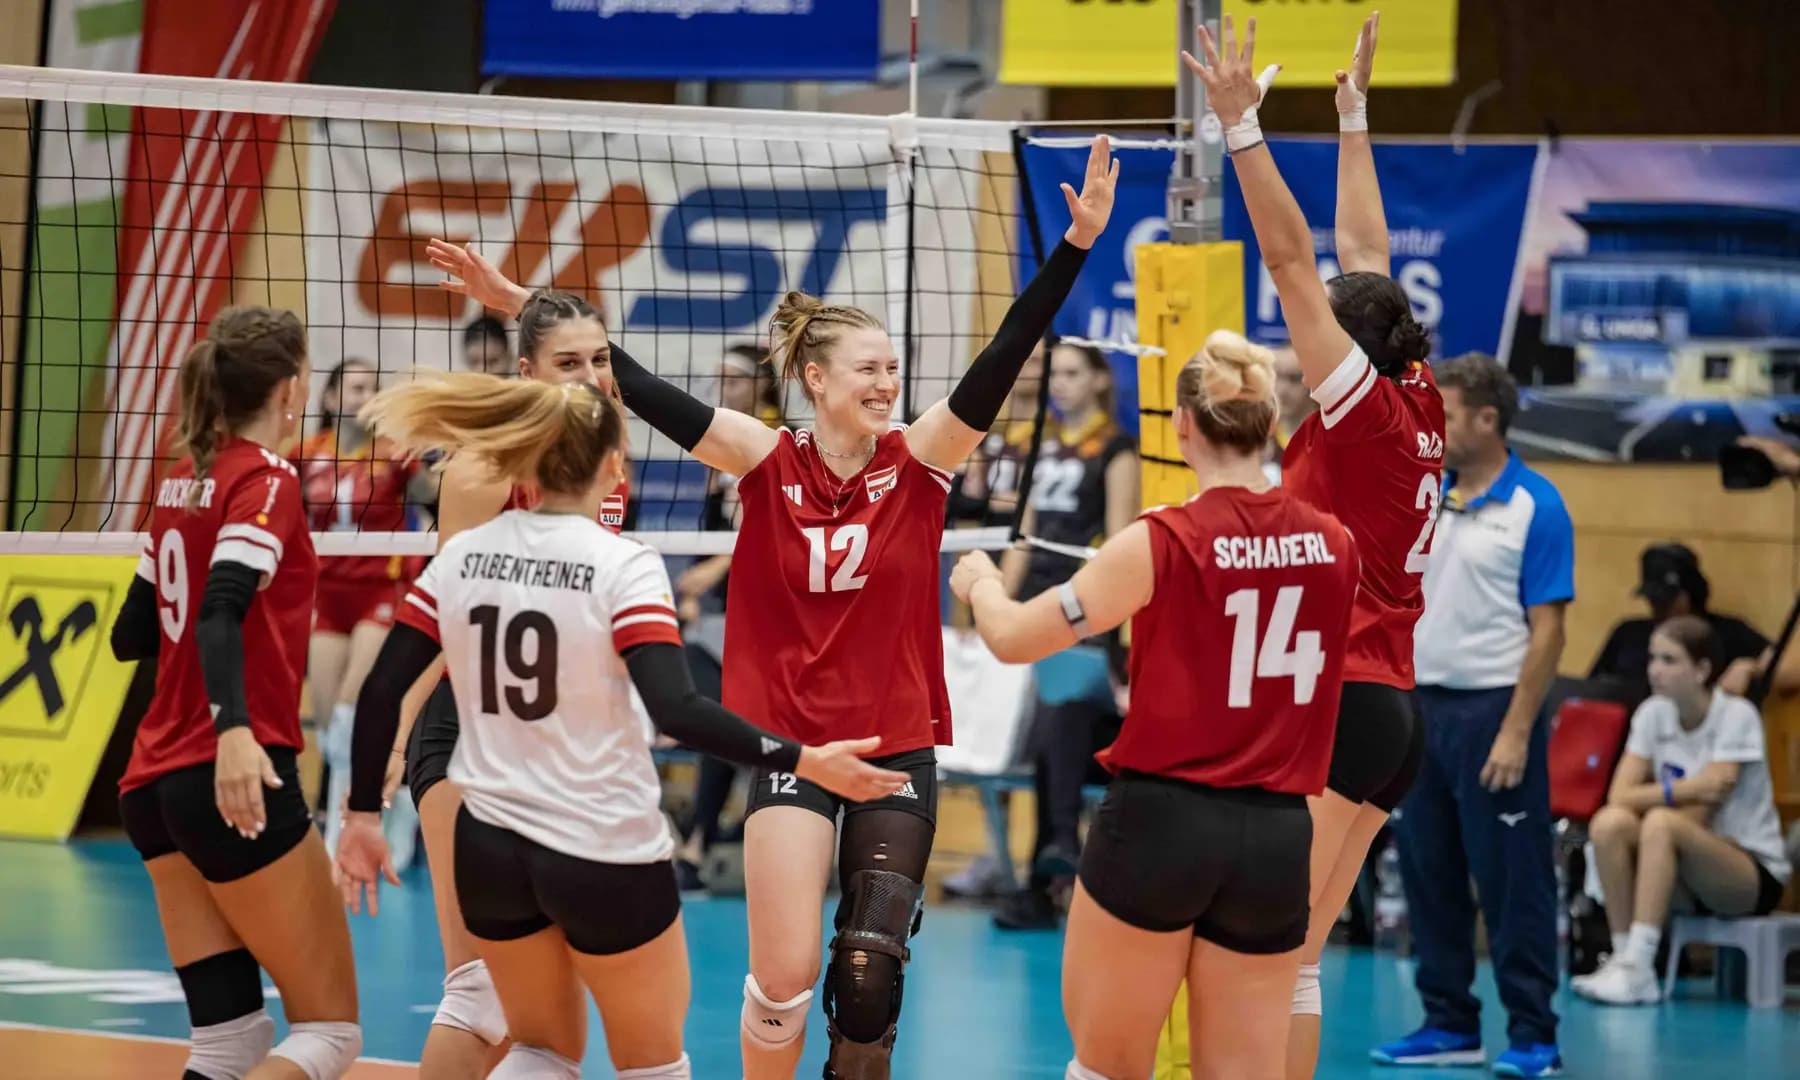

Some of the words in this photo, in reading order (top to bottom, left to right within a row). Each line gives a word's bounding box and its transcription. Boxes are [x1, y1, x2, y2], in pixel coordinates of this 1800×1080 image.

[603, 514, 621, 524] AUT
[801, 524, 869, 593] 12
[158, 528, 189, 643] 9
[469, 604, 559, 722] 19
[1224, 585, 1326, 708] 14
[768, 772, 798, 795] 12
